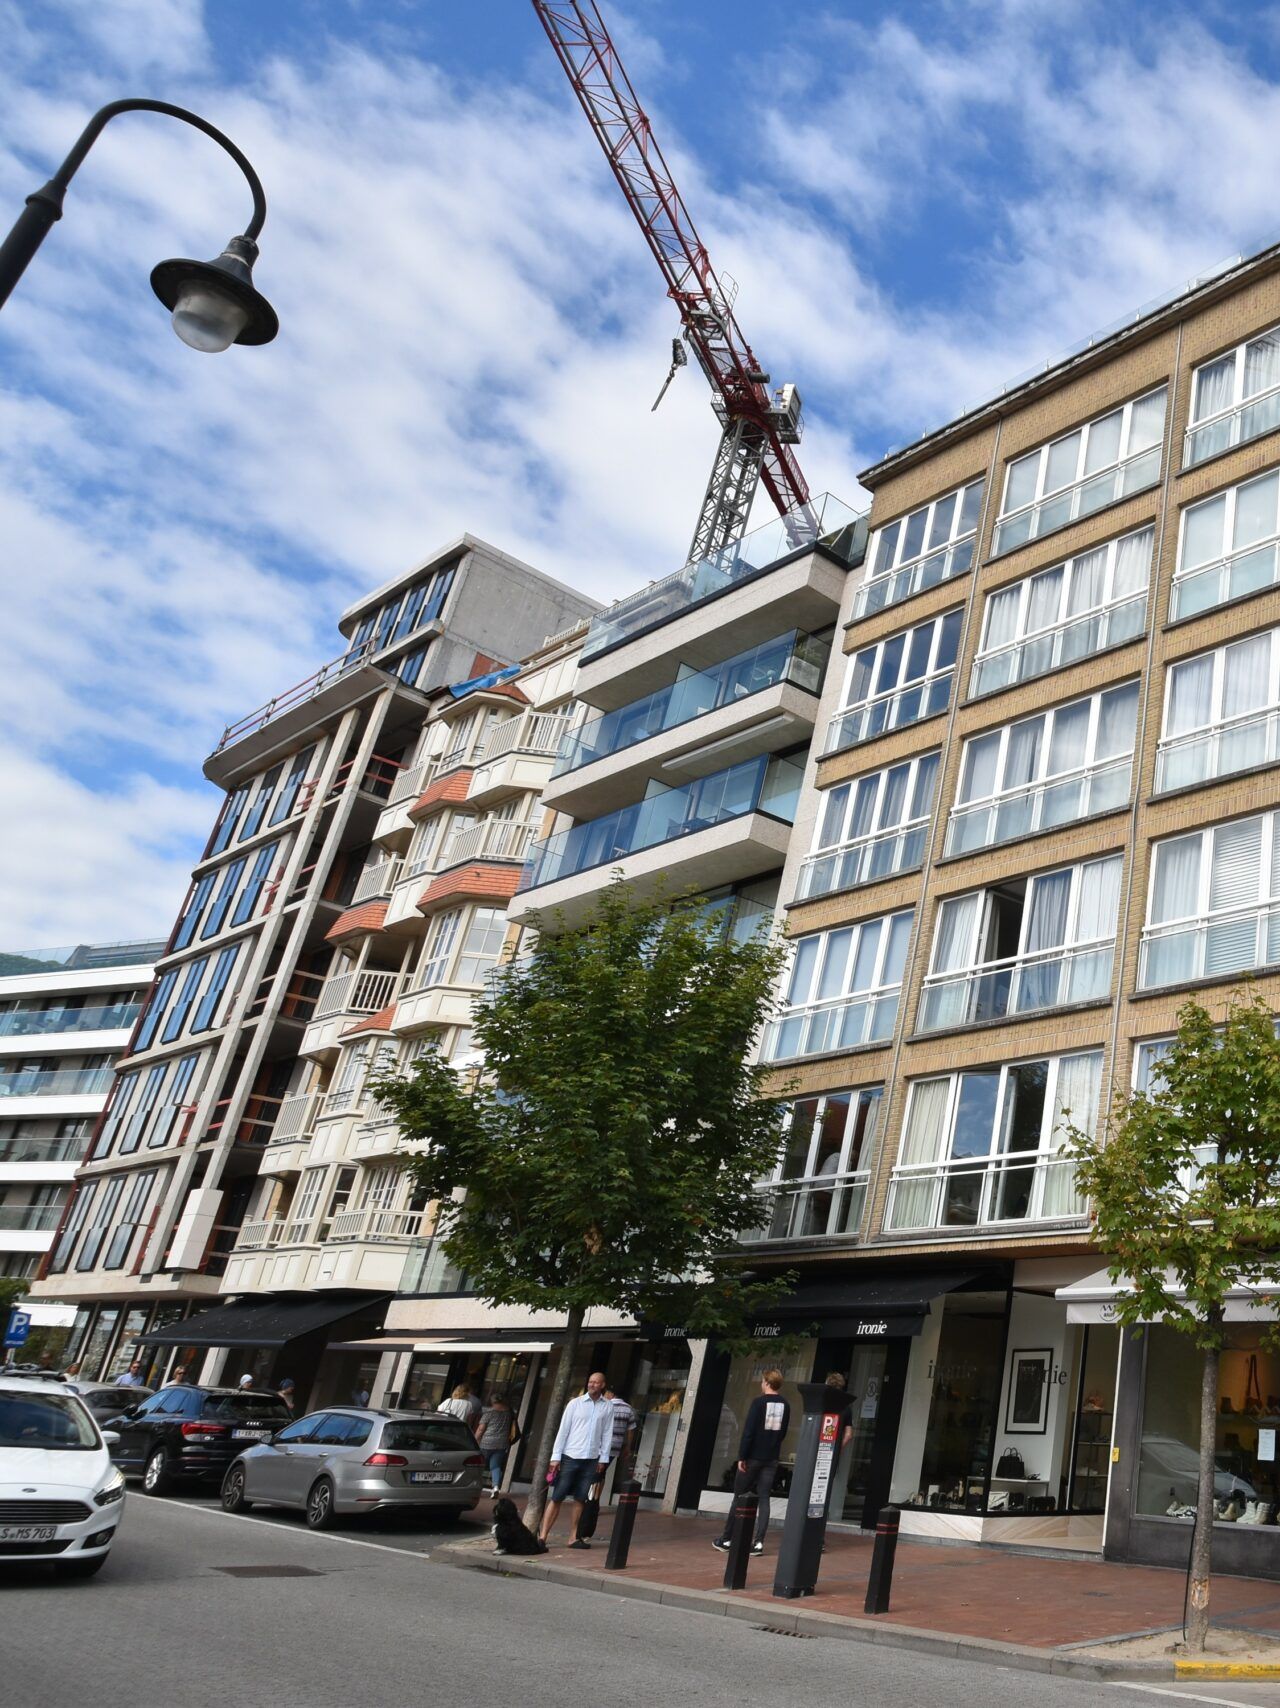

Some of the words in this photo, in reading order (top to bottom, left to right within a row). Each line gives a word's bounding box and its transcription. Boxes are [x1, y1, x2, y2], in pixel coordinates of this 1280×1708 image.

[10, 1313, 29, 1334] P
[664, 1324, 688, 1338] ironie
[753, 1322, 781, 1337] ironie
[856, 1320, 888, 1335] ironie
